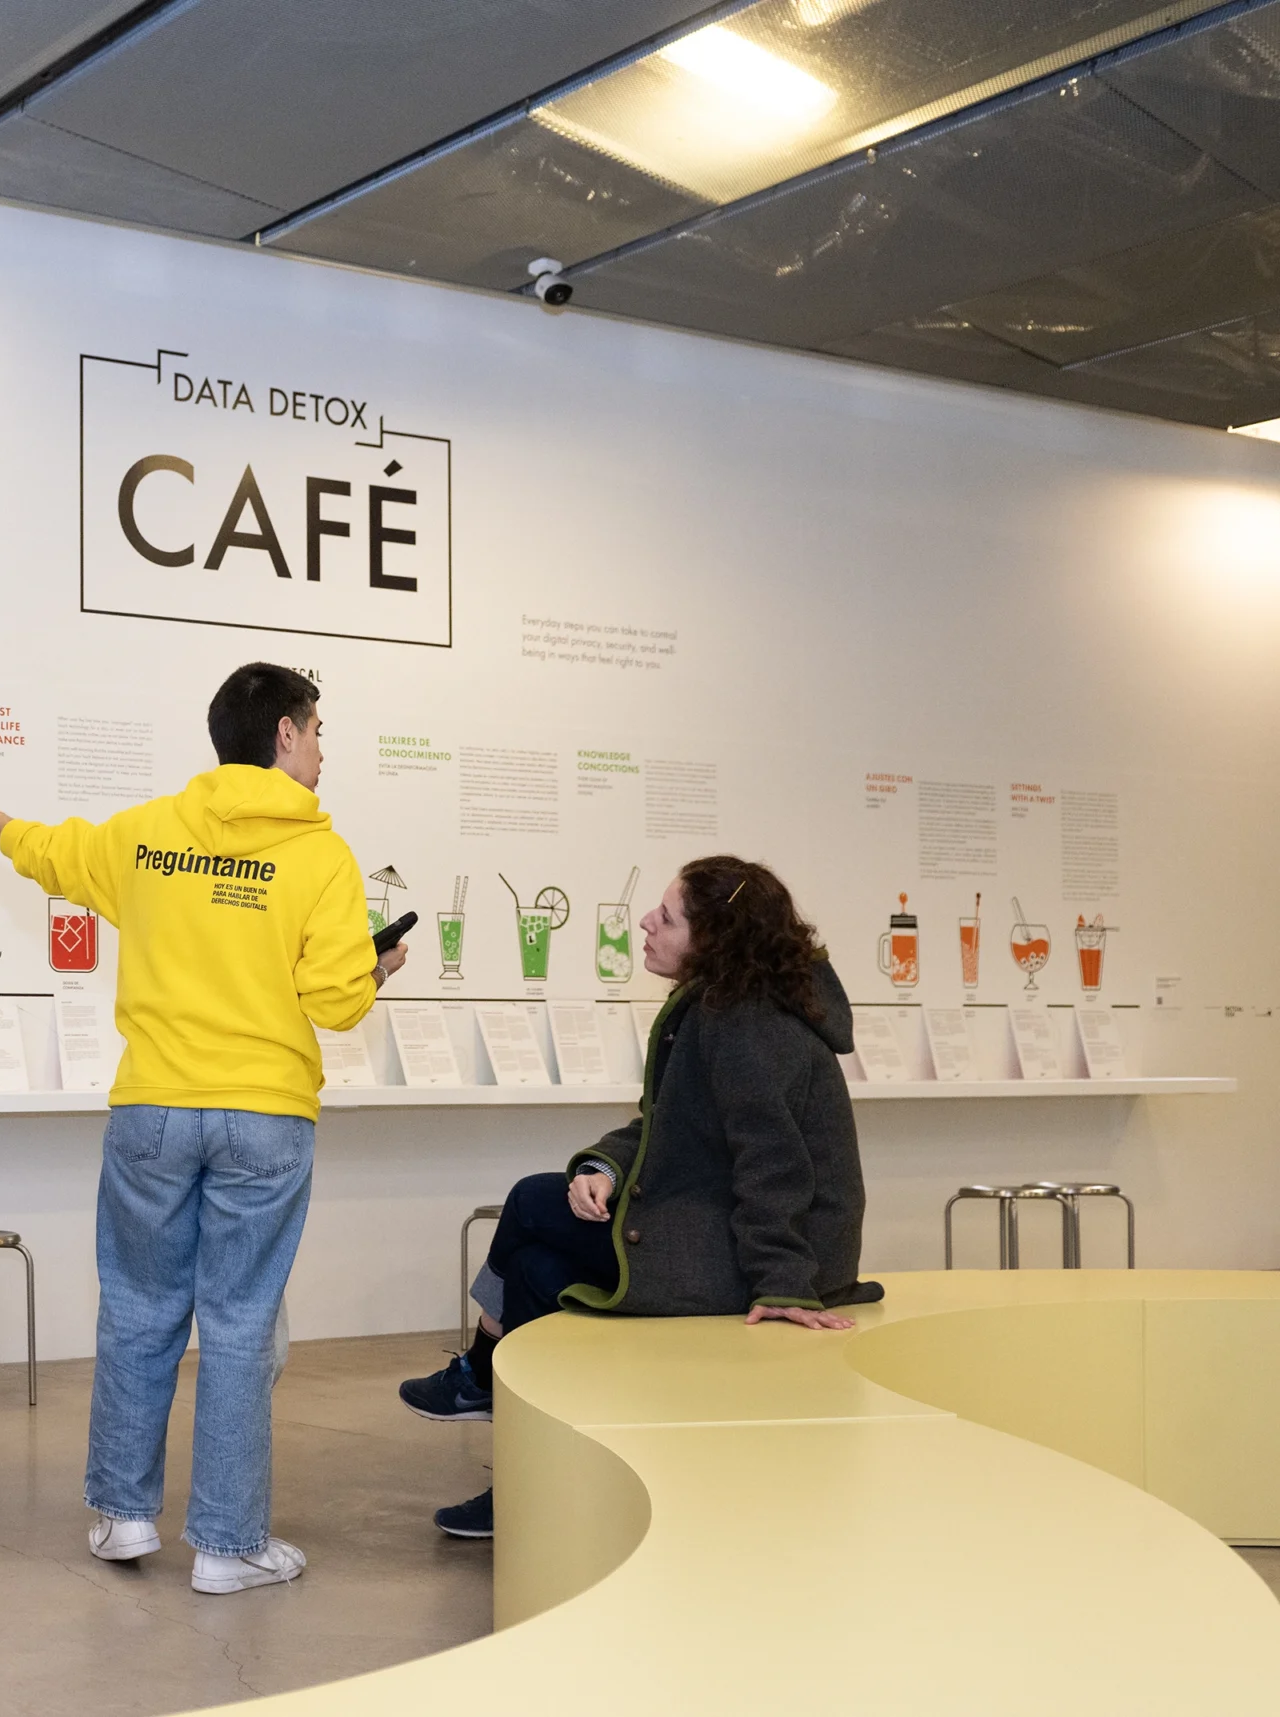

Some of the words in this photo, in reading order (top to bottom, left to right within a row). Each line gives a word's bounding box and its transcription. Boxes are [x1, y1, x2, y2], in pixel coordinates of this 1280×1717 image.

[174, 373, 255, 413] DATA
[269, 388, 367, 430] DETOX
[118, 454, 417, 592] CAFÉ
[0, 721, 21, 731] LIFE
[379, 735, 417, 746] ELIXIRES
[419, 738, 430, 747] DE
[379, 748, 451, 761] CONOCIMIENTO
[577, 750, 630, 761] KNOWLEDGE
[577, 762, 640, 774] CONCOCTIONS
[136, 844, 276, 882] Pregúntame
[228, 892, 250, 900] HABLAR
[258, 887, 267, 895] DÍA
[211, 898, 239, 907] DERECHOS
[241, 902, 267, 911] DIGITALES
